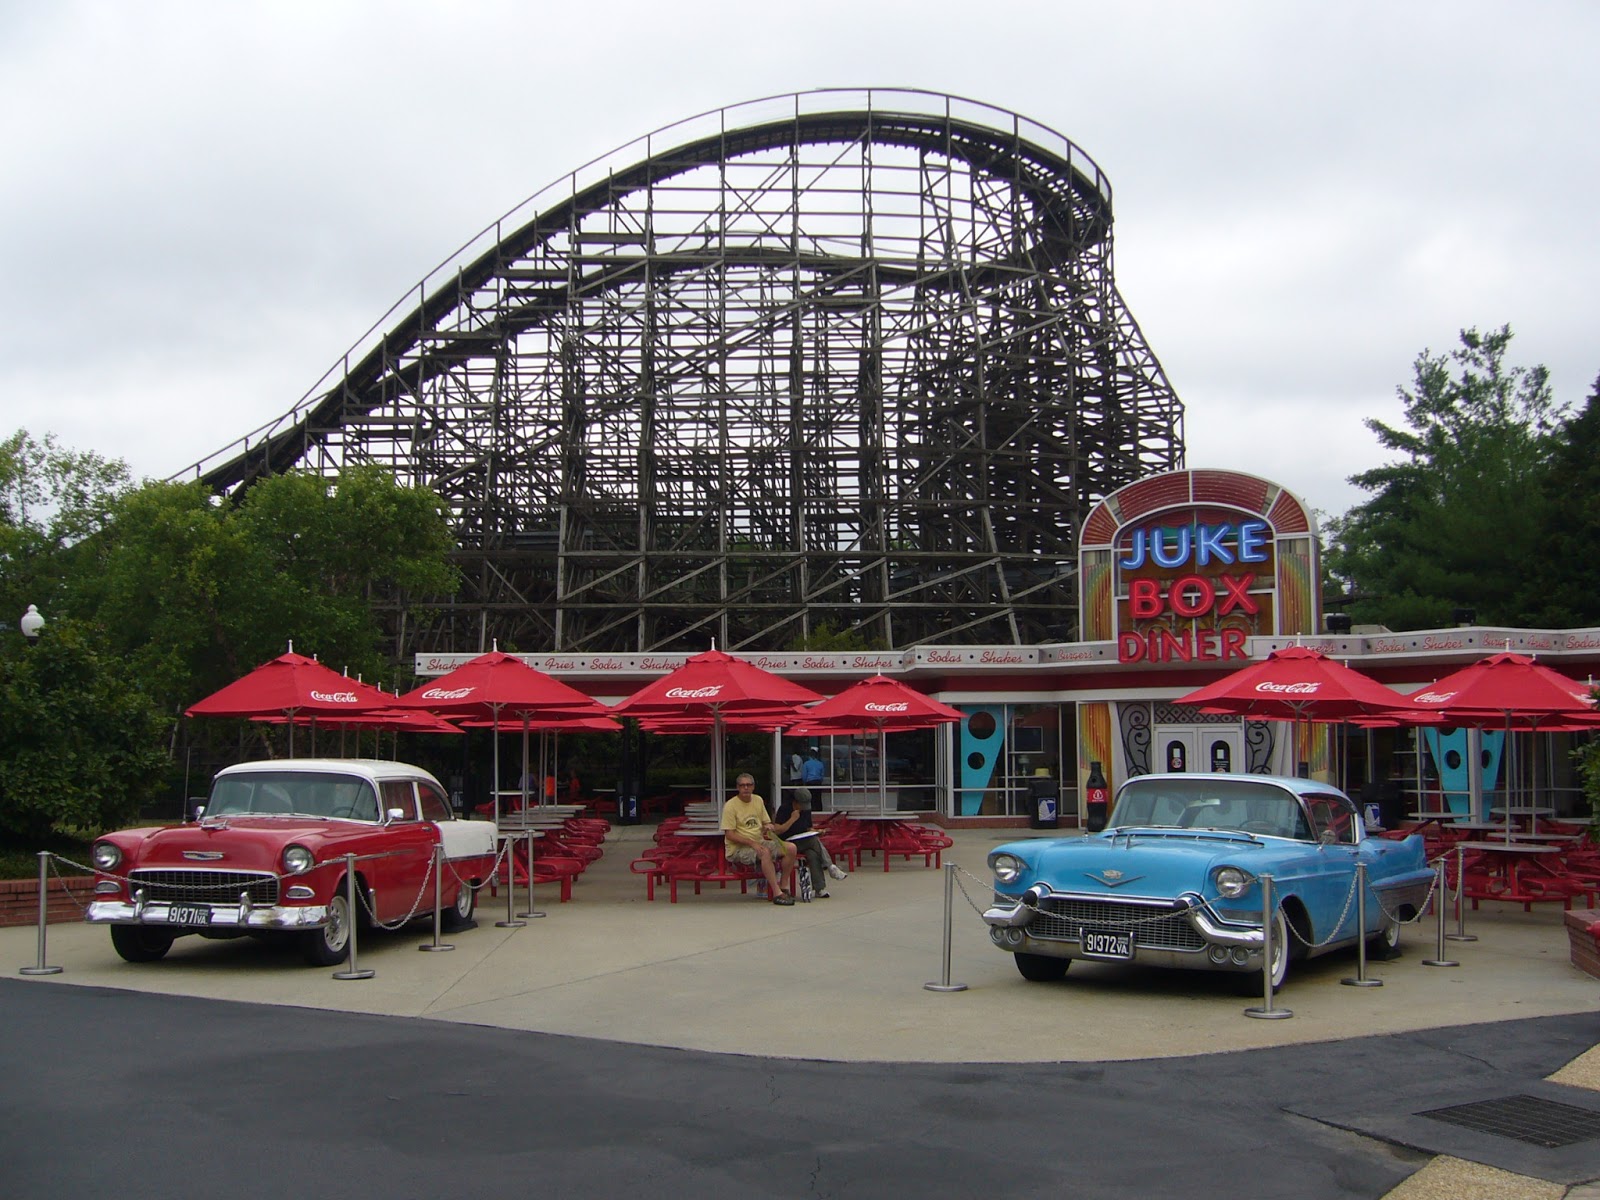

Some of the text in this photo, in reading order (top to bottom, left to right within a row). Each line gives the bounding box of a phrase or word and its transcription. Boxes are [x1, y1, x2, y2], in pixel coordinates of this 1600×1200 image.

[1119, 521, 1268, 570] JUKE
[1129, 572, 1259, 619] BOX
[1118, 627, 1248, 664] DINER
[1422, 636, 1463, 650] Shakes
[927, 651, 962, 663] Sodas
[980, 651, 1023, 663] Shakes
[1057, 648, 1094, 660] Burgers
[427, 658, 467, 670] Shak
[545, 658, 575, 670] Fries
[590, 658, 623, 669] Sodas
[757, 656, 787, 668] Fries
[803, 657, 835, 669] Sodas
[852, 657, 893, 668] Shakes
[310, 690, 358, 702] Coca-Cola
[169, 907, 199, 924] 91371
[1087, 933, 1117, 953] 91372
